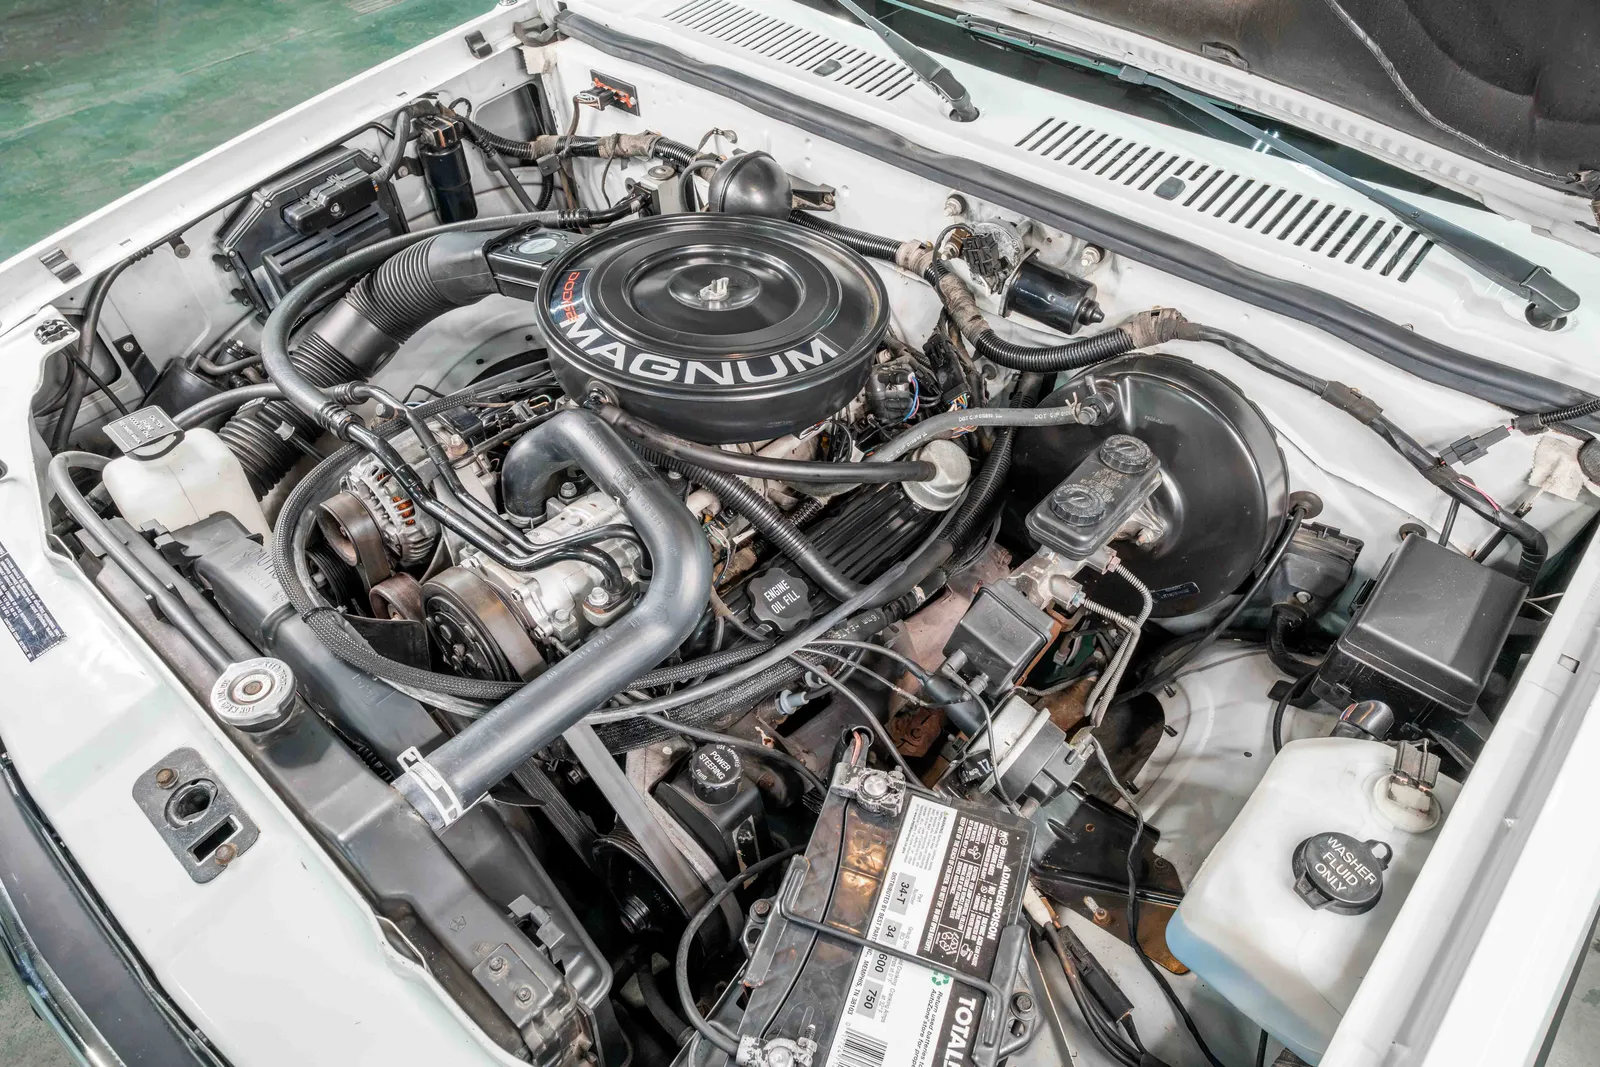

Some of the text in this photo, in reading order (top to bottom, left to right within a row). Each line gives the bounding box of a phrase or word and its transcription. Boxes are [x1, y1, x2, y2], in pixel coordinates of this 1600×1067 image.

[560, 313, 838, 385] MAGNUM
[764, 580, 790, 601] ENGINE
[771, 590, 800, 614] OIL FILL
[699, 754, 725, 780] STEERING
[710, 751, 731, 771] POWER
[1323, 852, 1358, 885] FLUID
[1327, 837, 1376, 885] WASHER
[882, 871, 897, 904] DISTRIBUTED
[1315, 863, 1347, 892] ONLY
[895, 881, 909, 904] 34-T
[880, 904, 887, 912] BY
[987, 870, 1012, 940] DANGER/POISON
[876, 912, 884, 925] BEST
[885, 924, 896, 937] 34
[855, 959, 869, 987] MEMPHIS,
[874, 953, 888, 973] 600
[853, 988, 860, 996] TN
[862, 988, 877, 1009] 750
[932, 991, 943, 1012] Return
[847, 996, 857, 1015] 38103
[918, 1020, 928, 1037] store
[927, 1013, 937, 1030] used
[915, 1038, 923, 1048] for
[919, 1030, 932, 1060] batteries
